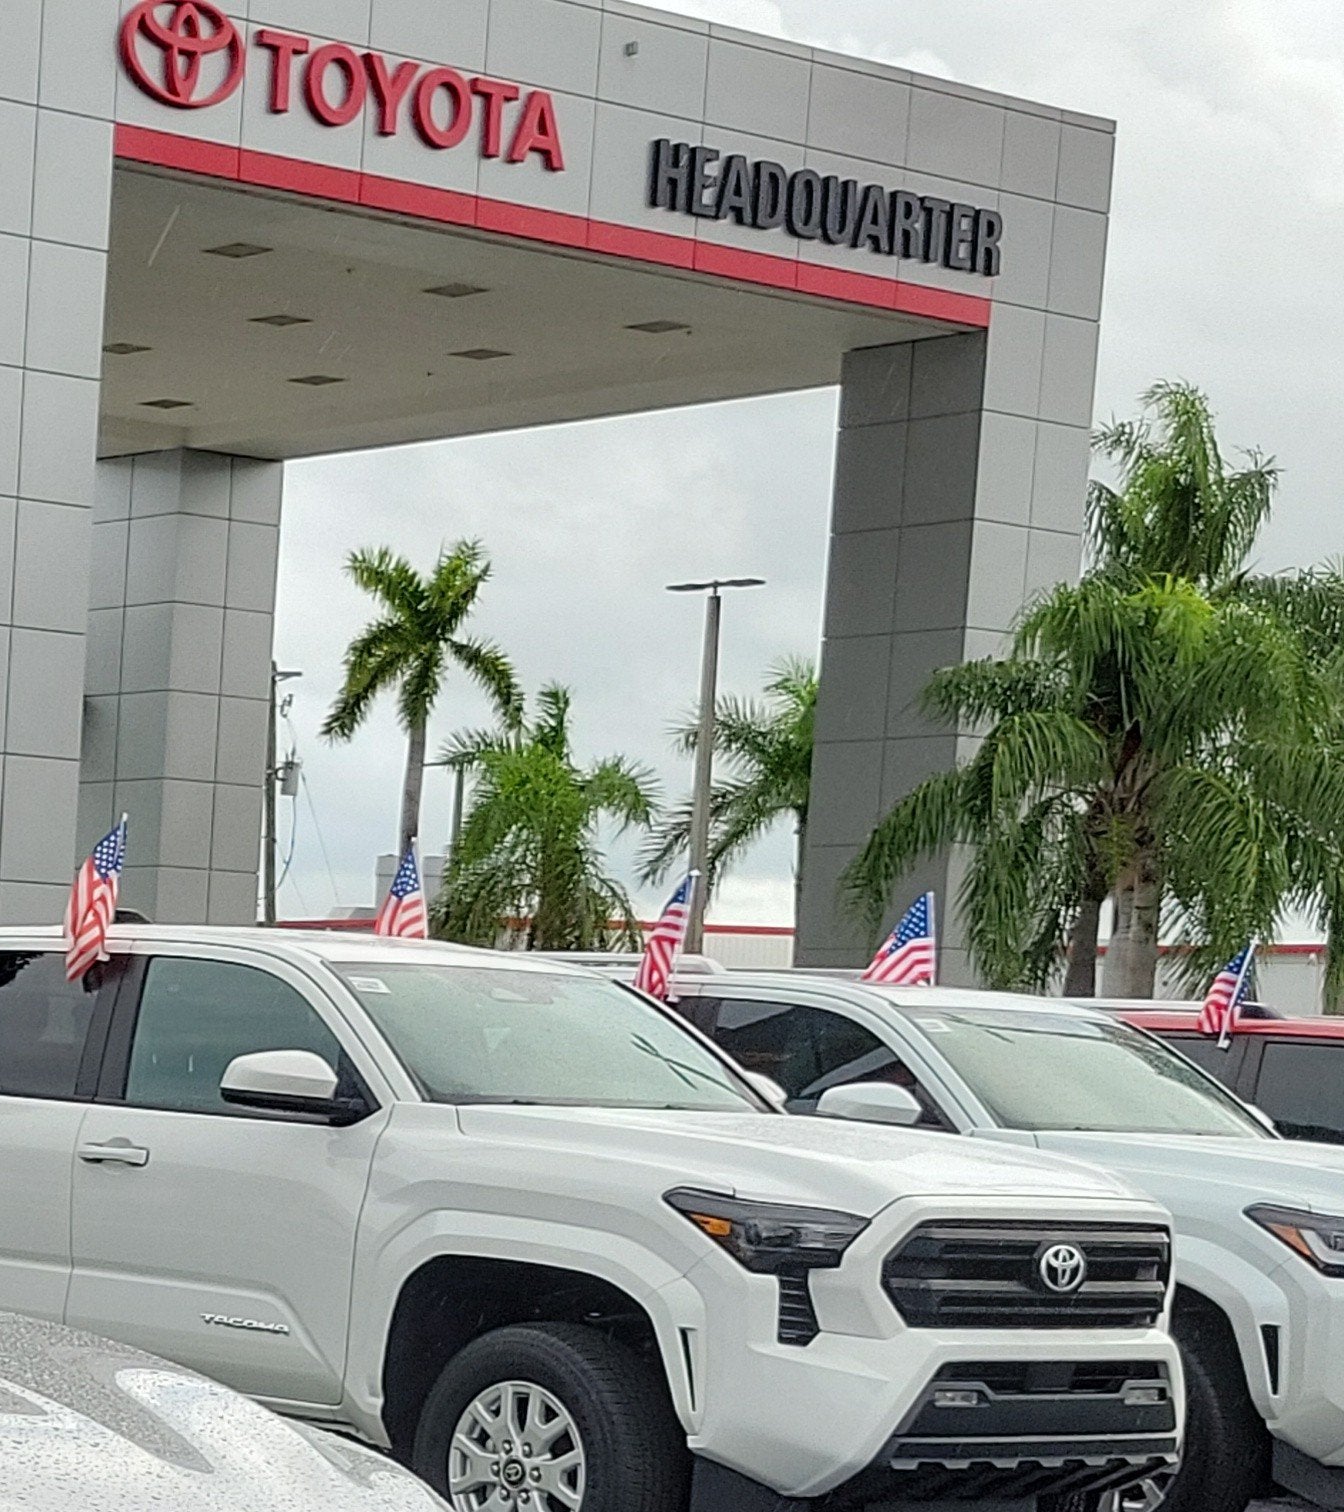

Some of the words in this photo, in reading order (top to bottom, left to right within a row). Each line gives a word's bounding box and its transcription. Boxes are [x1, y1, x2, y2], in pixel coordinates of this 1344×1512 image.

[256, 28, 565, 173] TOYOTA
[649, 138, 1003, 277] HEADQUARTER
[200, 1313, 289, 1334] TACOMA
